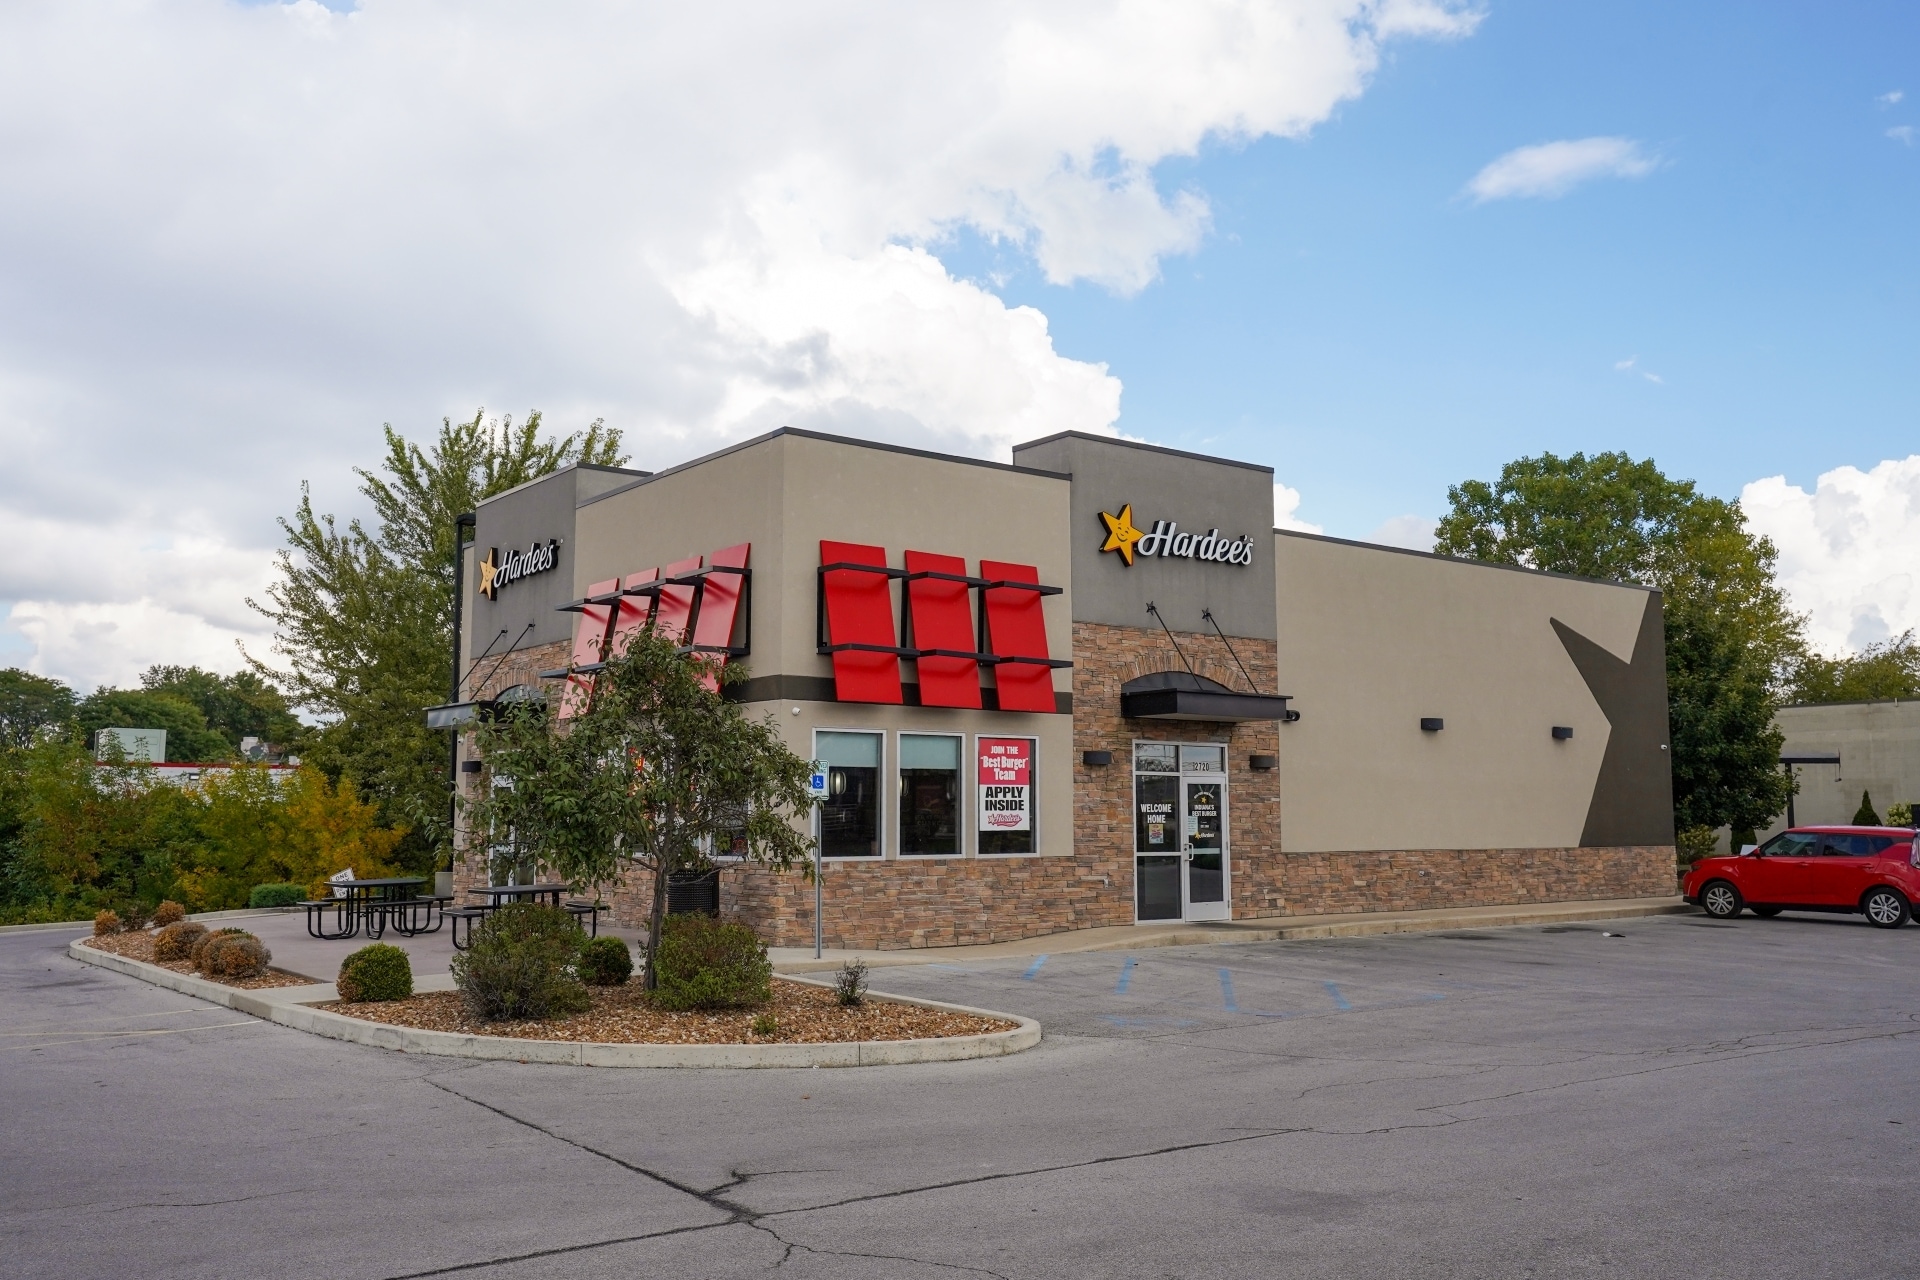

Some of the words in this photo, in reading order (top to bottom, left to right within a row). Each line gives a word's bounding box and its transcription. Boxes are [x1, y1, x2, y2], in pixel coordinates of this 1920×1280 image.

[1137, 519, 1254, 565] Hardee's
[493, 539, 557, 588] Hardee's
[990, 745, 1005, 754] JOIN
[1006, 746, 1019, 755] THE
[993, 768, 1016, 780] Team
[985, 786, 1024, 799] APPLY
[985, 799, 1024, 811] INSIDE
[1141, 804, 1172, 812] WELCOME
[1147, 815, 1166, 823] HOME
[335, 872, 348, 881] ONE
